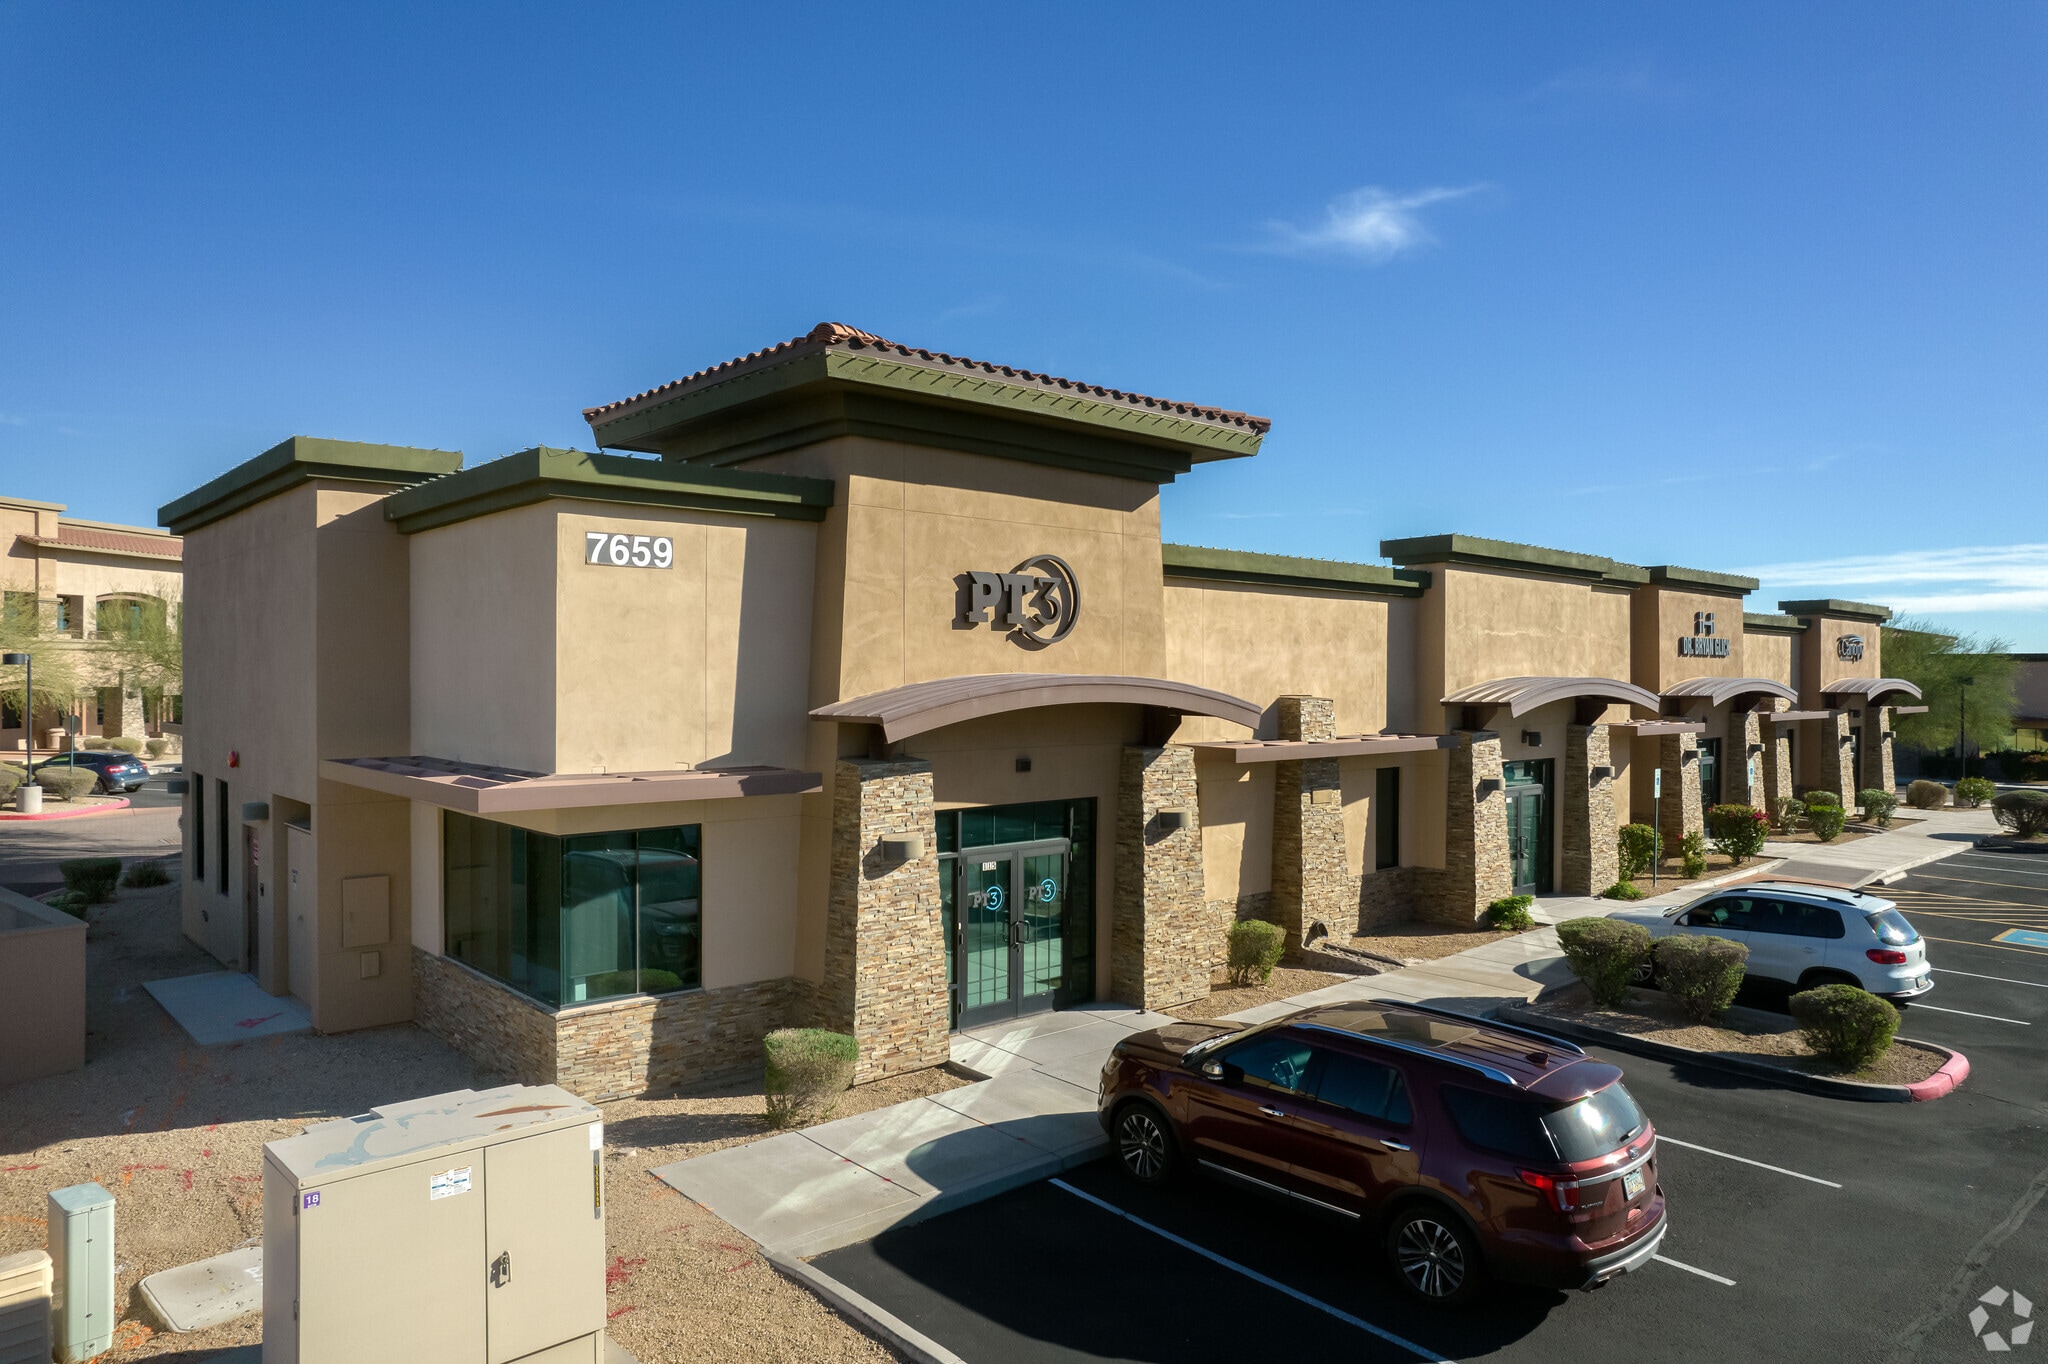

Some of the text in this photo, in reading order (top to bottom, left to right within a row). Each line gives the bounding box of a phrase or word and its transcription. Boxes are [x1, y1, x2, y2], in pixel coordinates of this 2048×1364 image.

[586, 532, 673, 568] 7659
[966, 570, 1062, 625] PT3
[1683, 637, 1694, 655] DR.
[1695, 637, 1714, 655] BRYAN
[973, 891, 998, 908] PT3
[1029, 884, 1052, 900] PT3
[306, 1194, 319, 1204] 18
